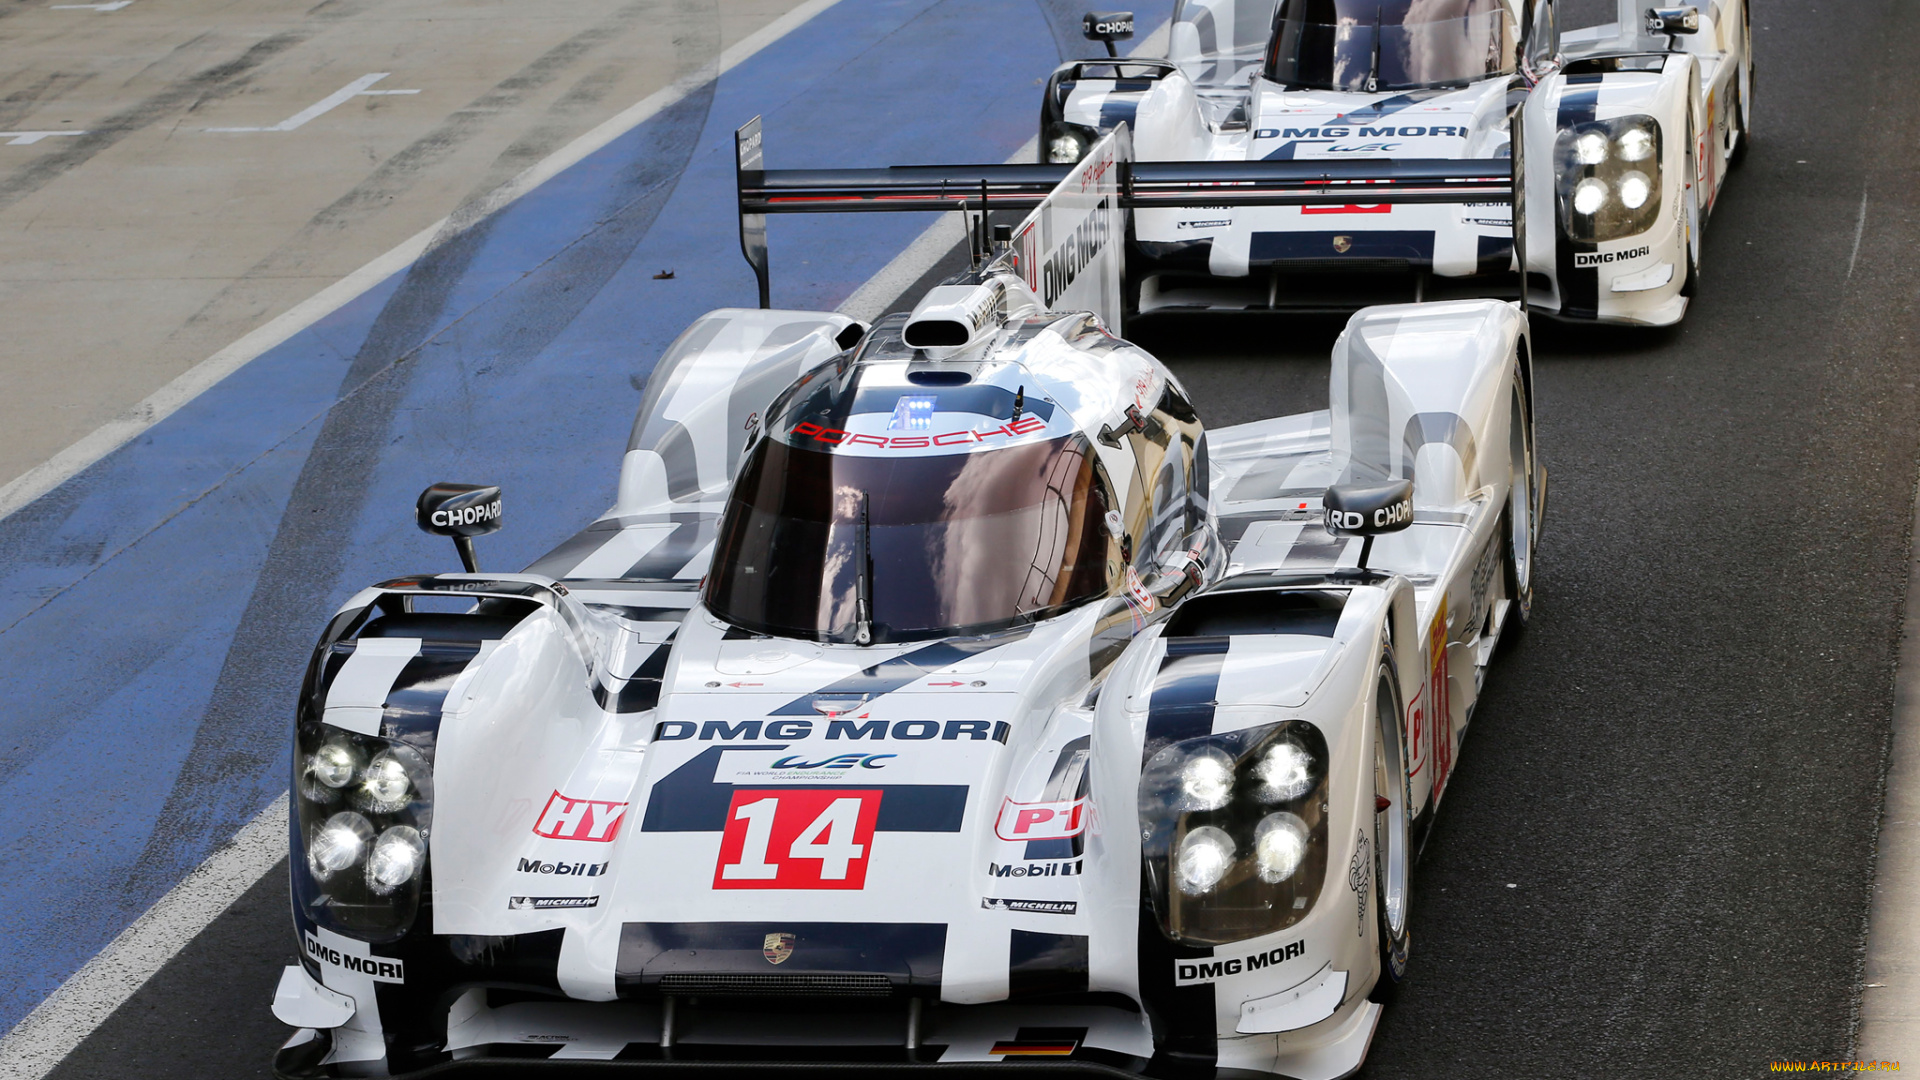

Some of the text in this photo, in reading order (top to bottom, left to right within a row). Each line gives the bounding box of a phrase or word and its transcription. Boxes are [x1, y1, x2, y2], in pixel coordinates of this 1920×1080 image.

[1254, 126, 1468, 139] DMG MORI
[1043, 194, 1110, 310] DMG MORI
[1576, 241, 1650, 265] DMG MORI
[790, 417, 1046, 449] PORSCHE
[431, 500, 502, 526] CHOPARD
[650, 720, 1011, 746] DMG MORI
[771, 753, 898, 770] WEC
[537, 796, 628, 839] HY
[1013, 803, 1083, 834] P1
[722, 798, 864, 879] 14
[517, 858, 586, 876] Mobil
[989, 862, 1058, 877] Mobil
[536, 898, 597, 906] MICHELIN
[1010, 901, 1076, 911] MICHELIN
[307, 937, 403, 979] DMG MORI
[1179, 939, 1305, 980] DMG MORI
